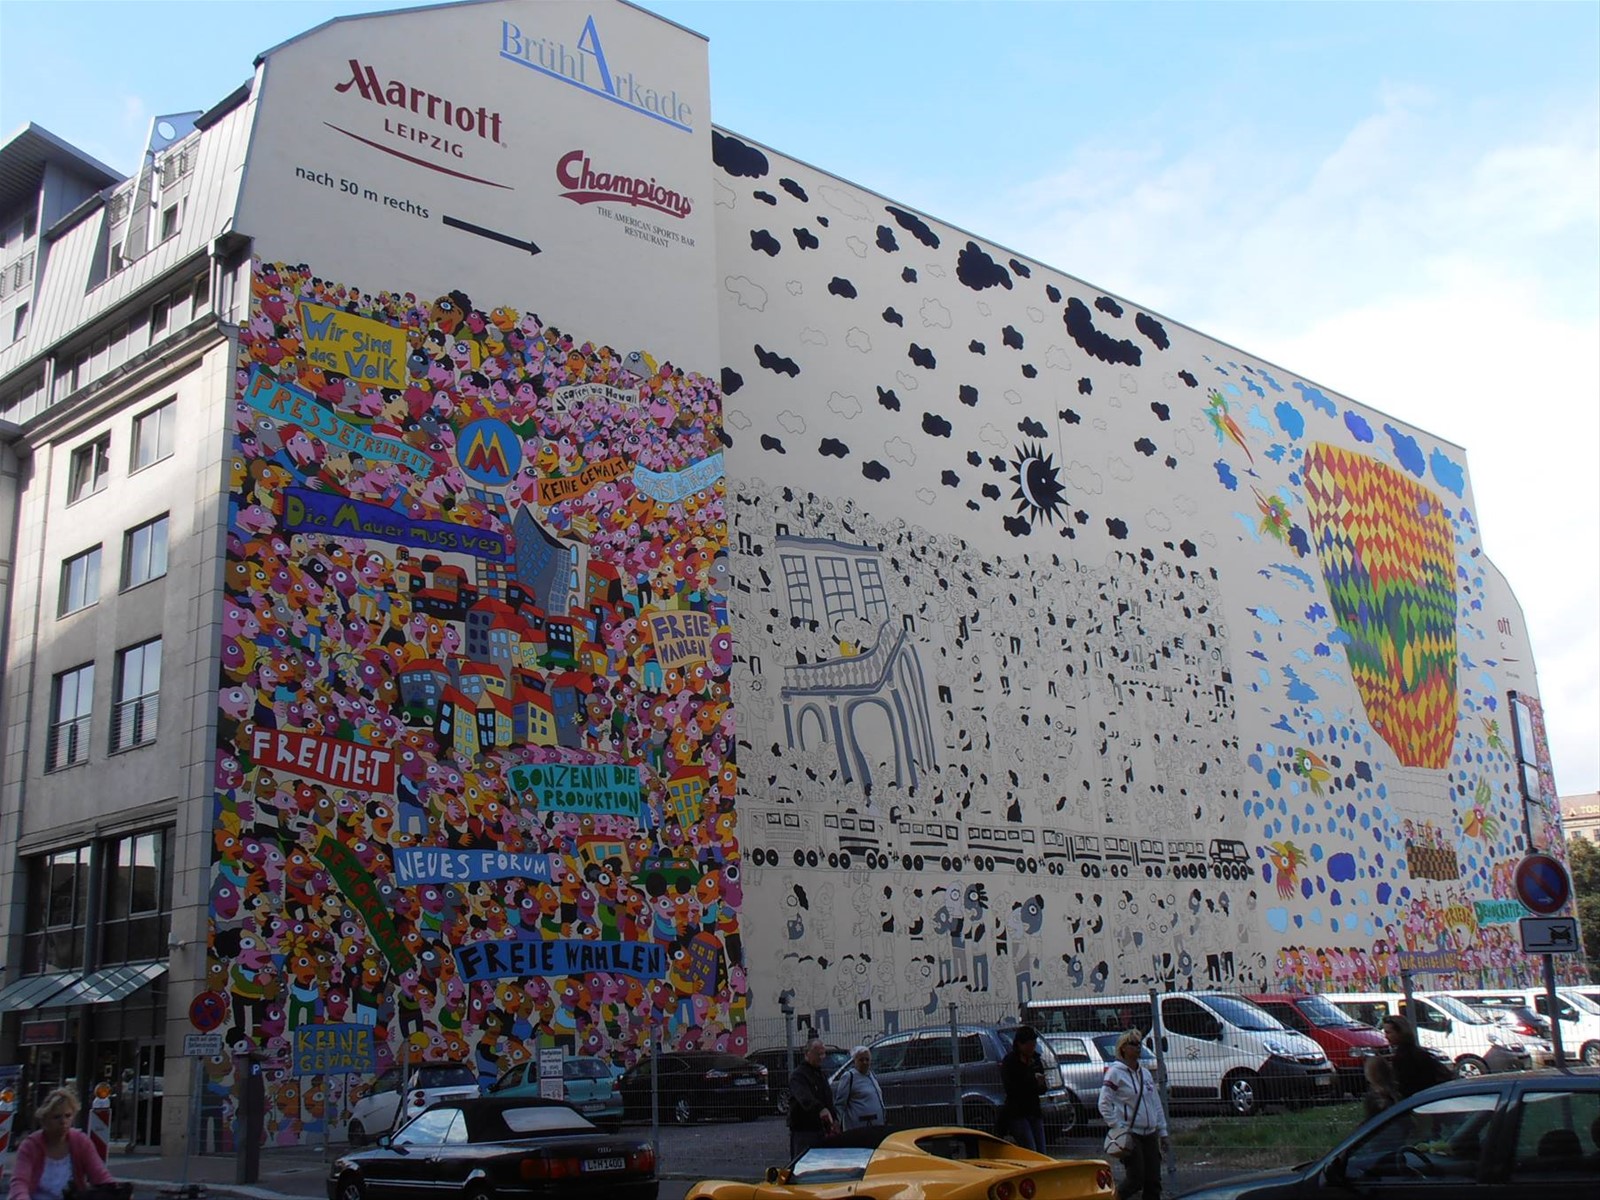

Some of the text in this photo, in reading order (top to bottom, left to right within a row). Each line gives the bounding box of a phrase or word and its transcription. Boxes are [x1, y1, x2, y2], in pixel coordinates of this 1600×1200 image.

[334, 59, 503, 144] Marriott
[384, 118, 464, 159] LEIPZIG
[295, 166, 430, 219] nach 50 m rechts
[556, 149, 692, 218] Champions
[597, 206, 695, 248] THE AMERICAN SPORTS BAR
[624, 226, 669, 248] RESTAURANT
[302, 304, 349, 342] Wir
[250, 375, 433, 472] PRESSEFREIHEIT
[540, 477, 579, 500] KEINE
[286, 495, 328, 527] Die
[332, 503, 404, 537] Mauer
[651, 614, 710, 642] FREIE
[613, 765, 637, 786] DIE
[543, 789, 639, 815] PRODUKTION
[397, 851, 547, 882] NEUES FORUM
[458, 941, 556, 980] FREIE
[298, 1029, 369, 1056] KEINE
